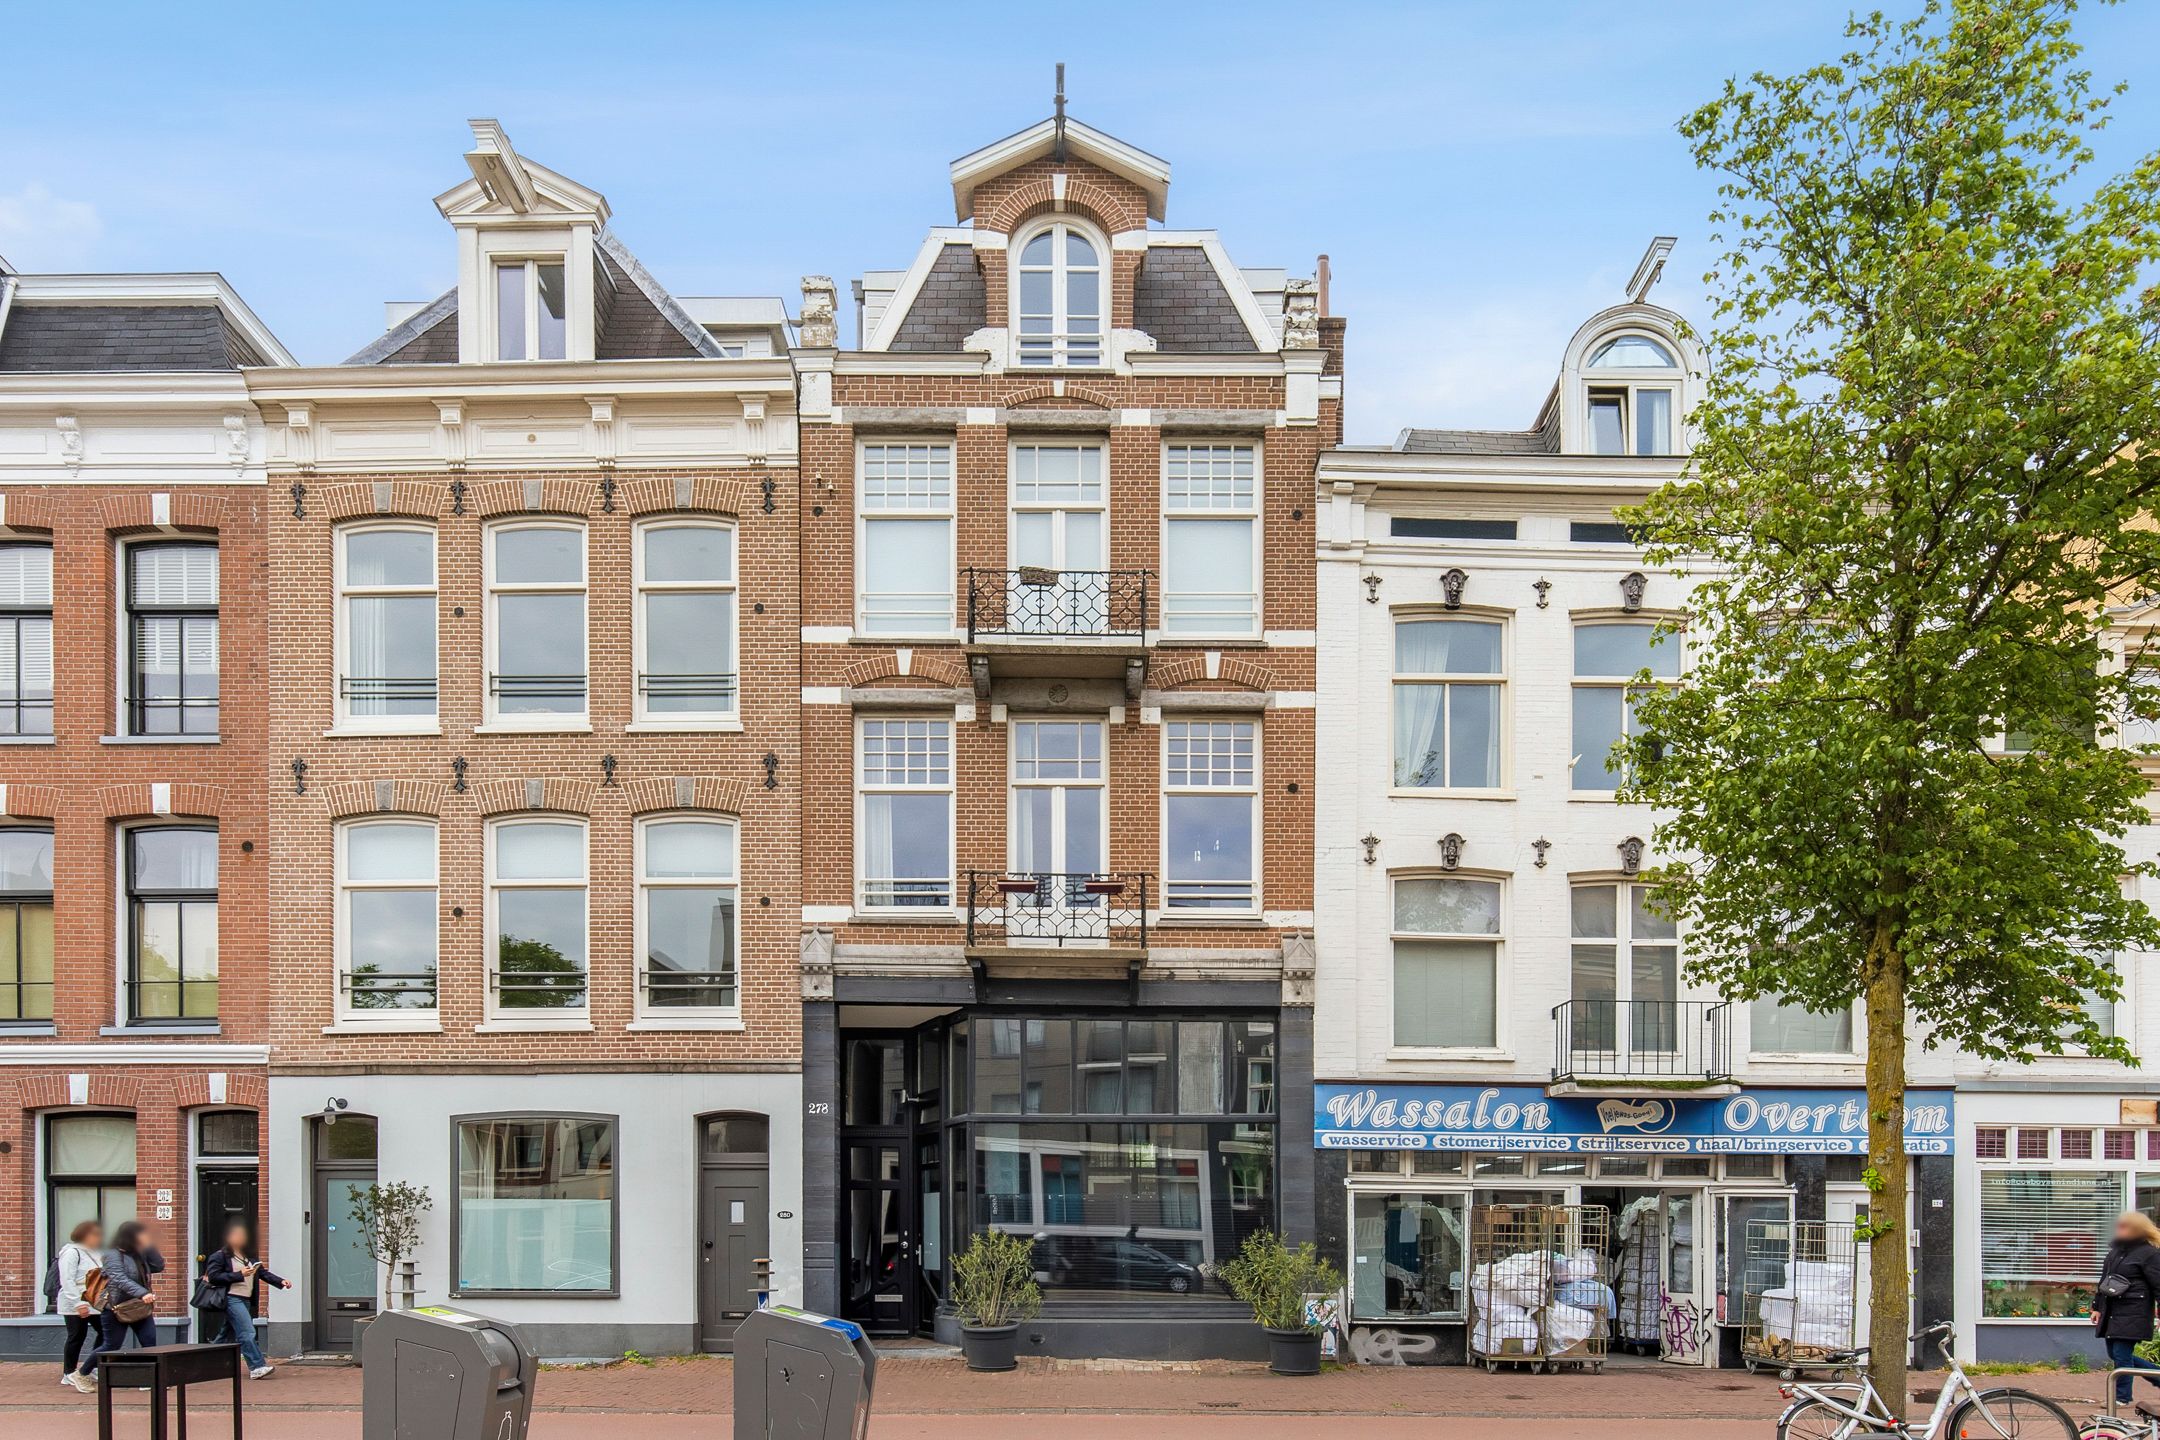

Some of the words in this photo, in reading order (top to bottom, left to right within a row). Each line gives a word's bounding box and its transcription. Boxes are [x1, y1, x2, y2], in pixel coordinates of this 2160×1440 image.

[808, 1102, 829, 1114] 278
[1327, 1088, 1551, 1131] Wassalon
[1724, 1095, 1950, 1134] Overtm
[1328, 1134, 1421, 1147] wasservice
[1439, 1135, 1567, 1150] stomerijservice
[1581, 1137, 1686, 1151] strijkservice
[1701, 1137, 1848, 1152] haal/bringservice
